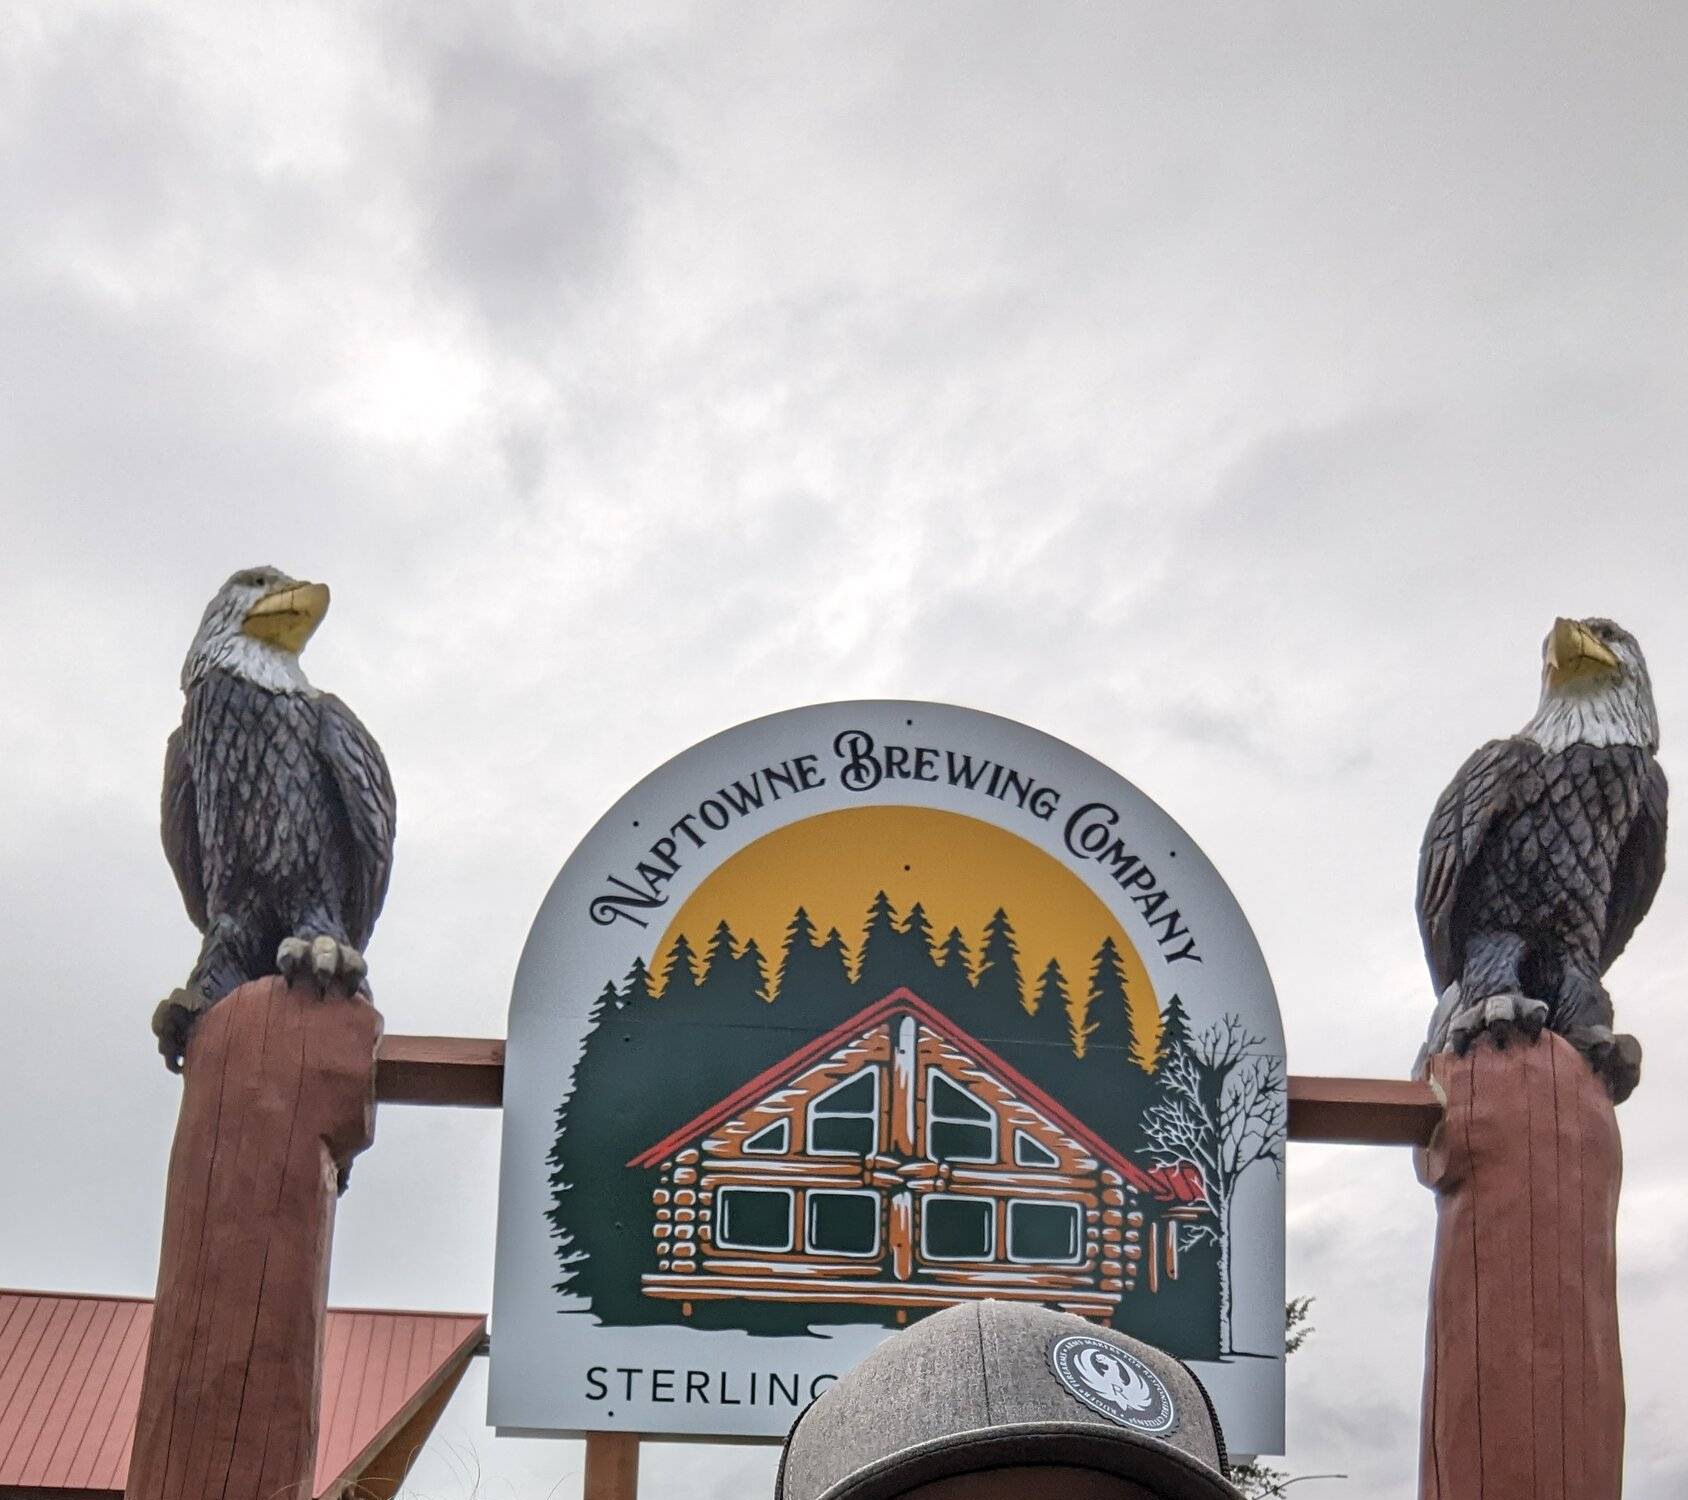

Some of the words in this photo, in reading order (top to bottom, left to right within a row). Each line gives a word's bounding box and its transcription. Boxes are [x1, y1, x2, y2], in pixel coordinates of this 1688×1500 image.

[588, 753, 827, 929] NAPTOWNE
[832, 729, 1062, 822] BREWING
[1063, 802, 1203, 966] COMPANY
